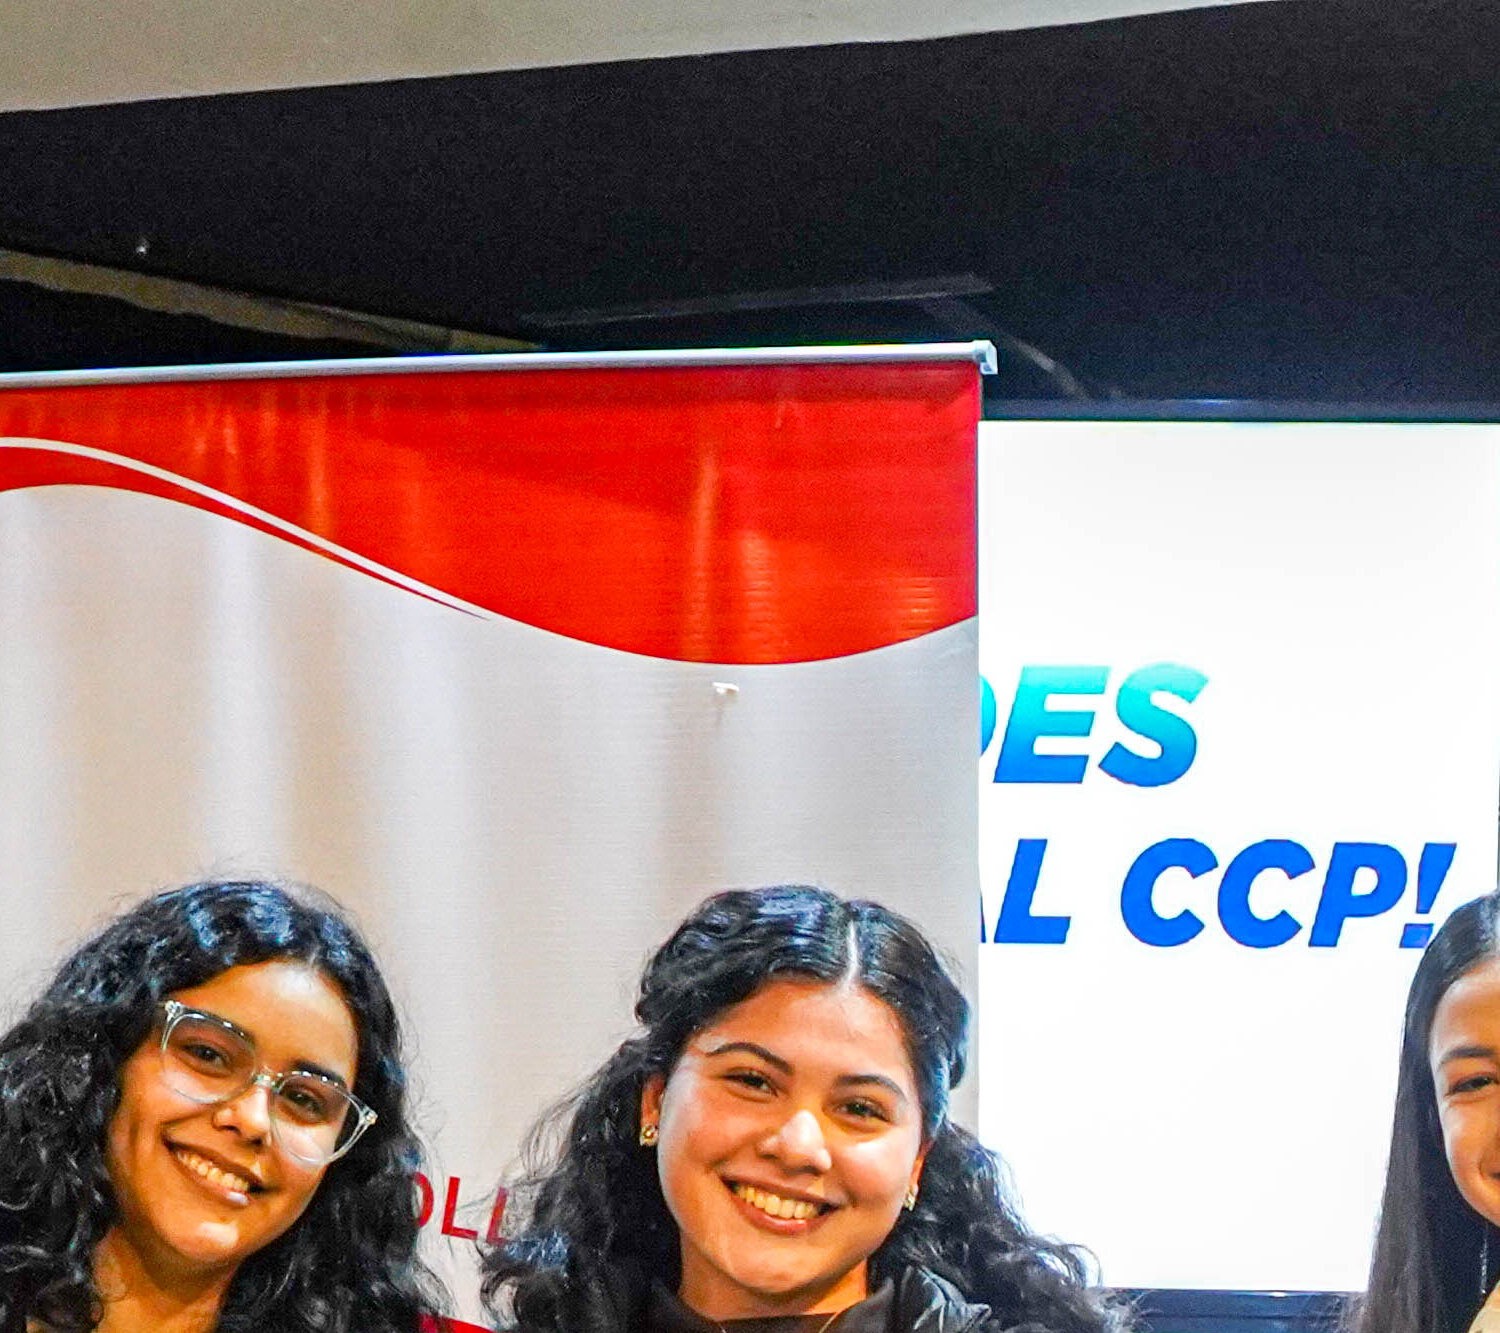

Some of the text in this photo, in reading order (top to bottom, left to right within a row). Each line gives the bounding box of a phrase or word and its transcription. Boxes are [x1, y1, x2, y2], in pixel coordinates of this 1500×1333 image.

[979, 661, 1210, 788] ES
[980, 837, 1458, 950] L CCP!
